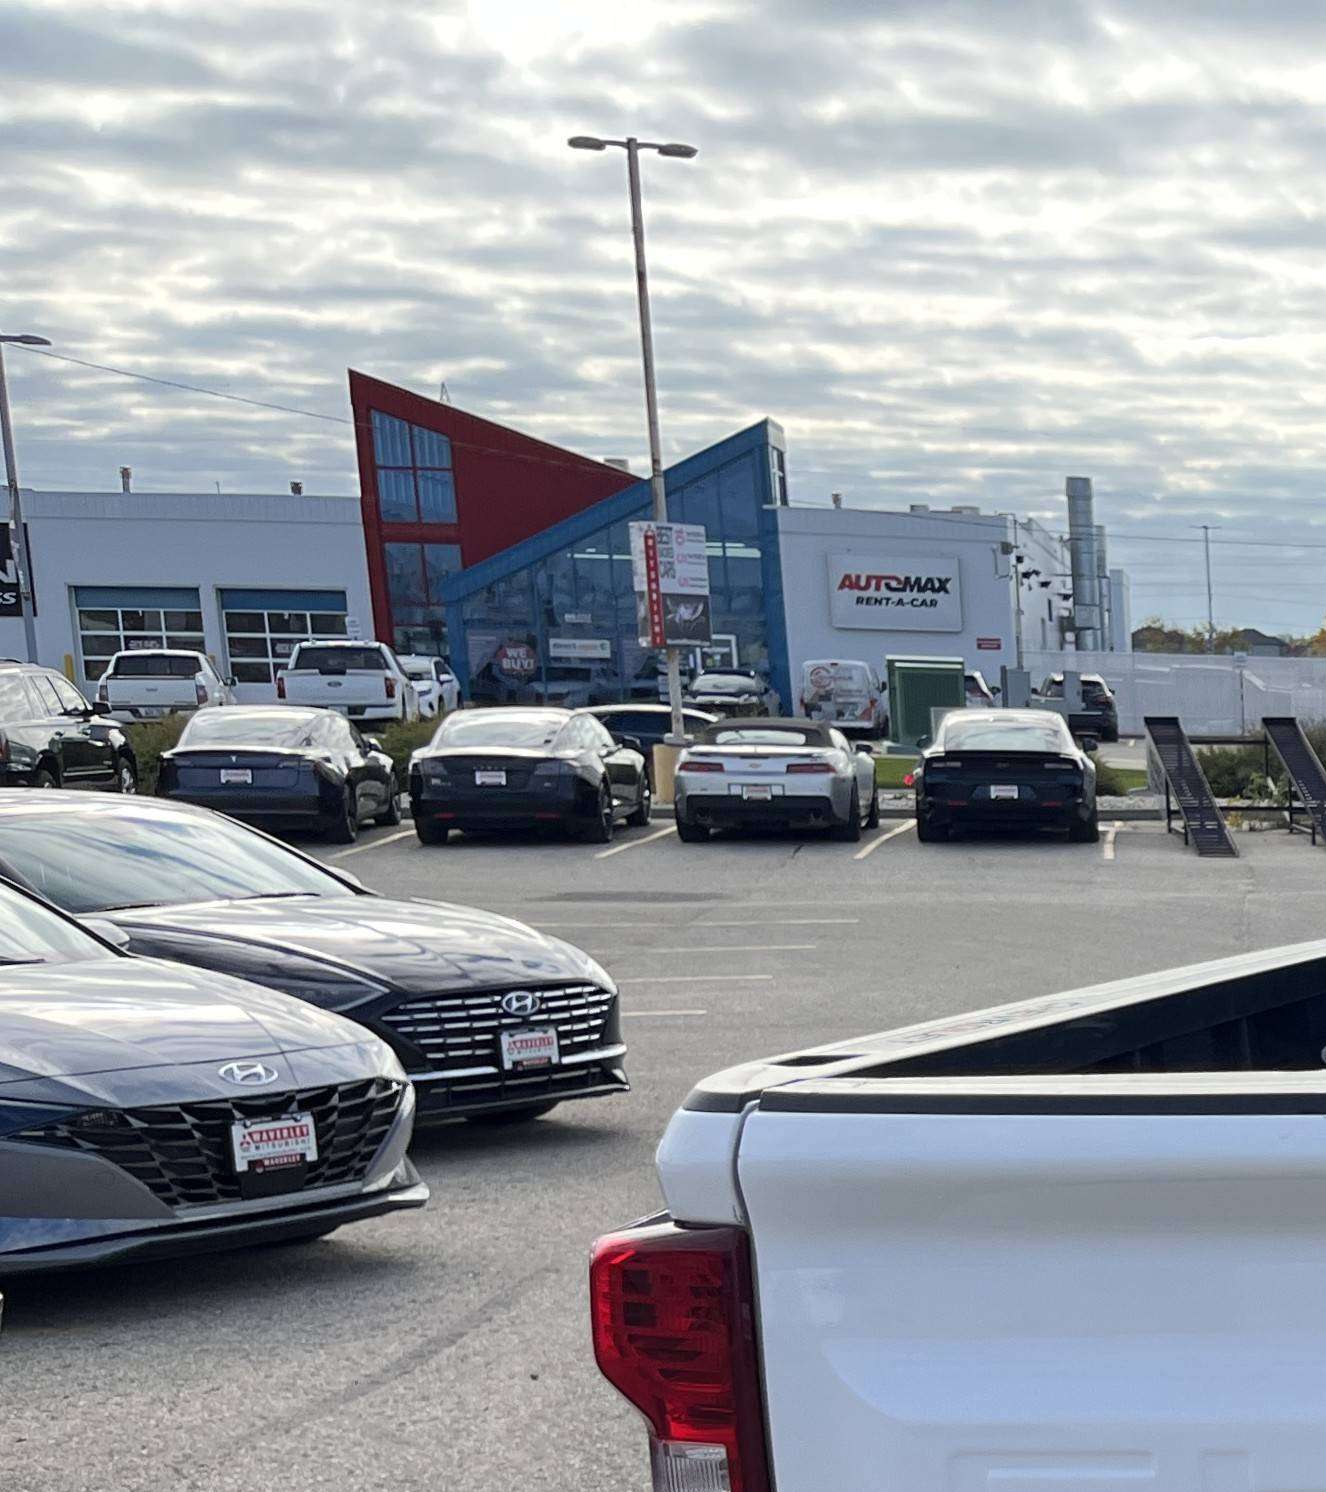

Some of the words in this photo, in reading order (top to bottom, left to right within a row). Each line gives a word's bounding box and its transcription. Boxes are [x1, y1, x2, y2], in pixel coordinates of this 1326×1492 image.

[837, 573, 952, 594] AUTOMAX
[856, 596, 938, 608] RENT-A-CAR
[506, 648, 527, 658] WE
